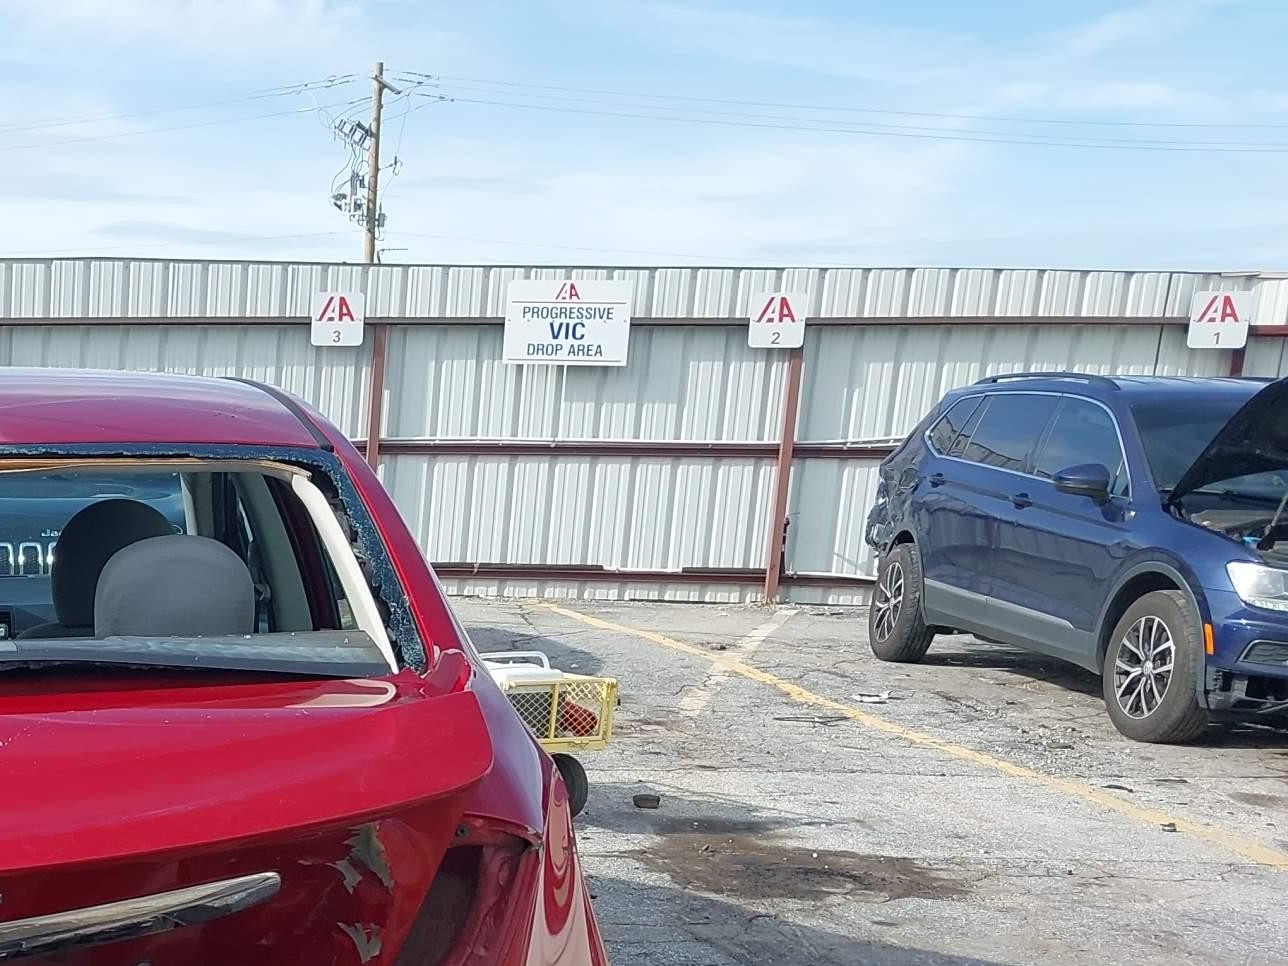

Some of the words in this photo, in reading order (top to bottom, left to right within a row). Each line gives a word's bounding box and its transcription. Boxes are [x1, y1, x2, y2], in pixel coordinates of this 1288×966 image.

[522, 306, 614, 320] PROGRESSIVE
[332, 330, 341, 343] 3
[549, 322, 586, 340] VIC
[770, 331, 781, 345] 2
[1213, 331, 1221, 345] 1
[526, 343, 563, 357] DROP
[567, 343, 603, 357] AREA
